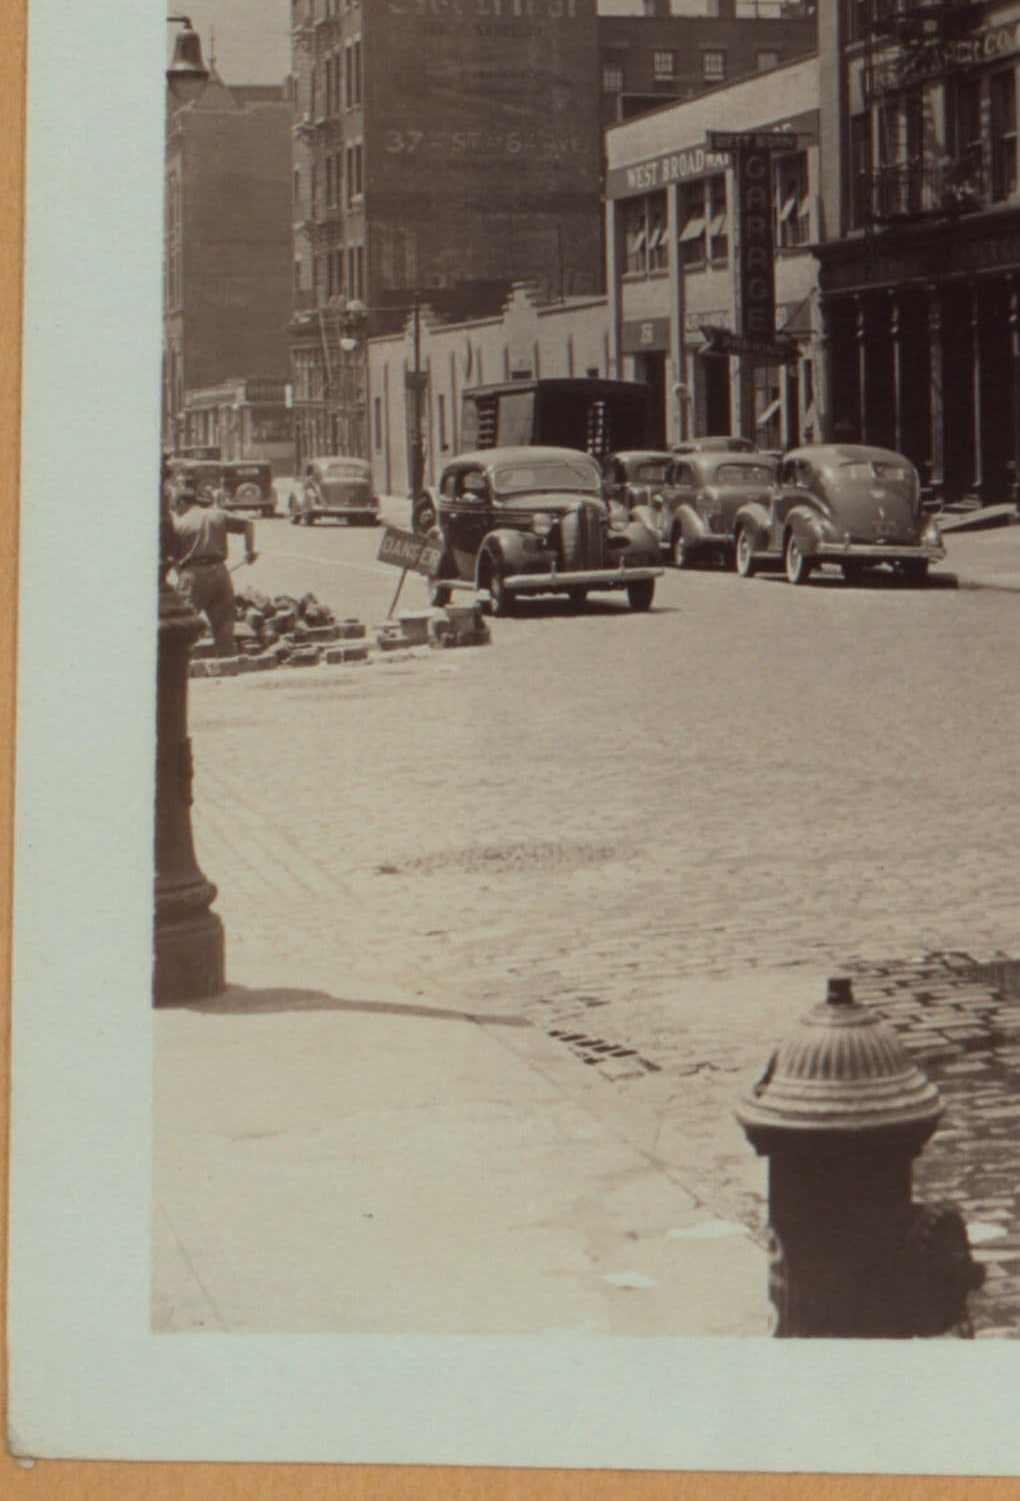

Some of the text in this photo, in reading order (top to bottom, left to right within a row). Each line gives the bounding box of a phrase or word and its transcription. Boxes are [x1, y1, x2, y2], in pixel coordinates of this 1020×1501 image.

[626, 161, 658, 188] WEST
[745, 155, 770, 332] GARAGE
[381, 536, 442, 570] DANGER
